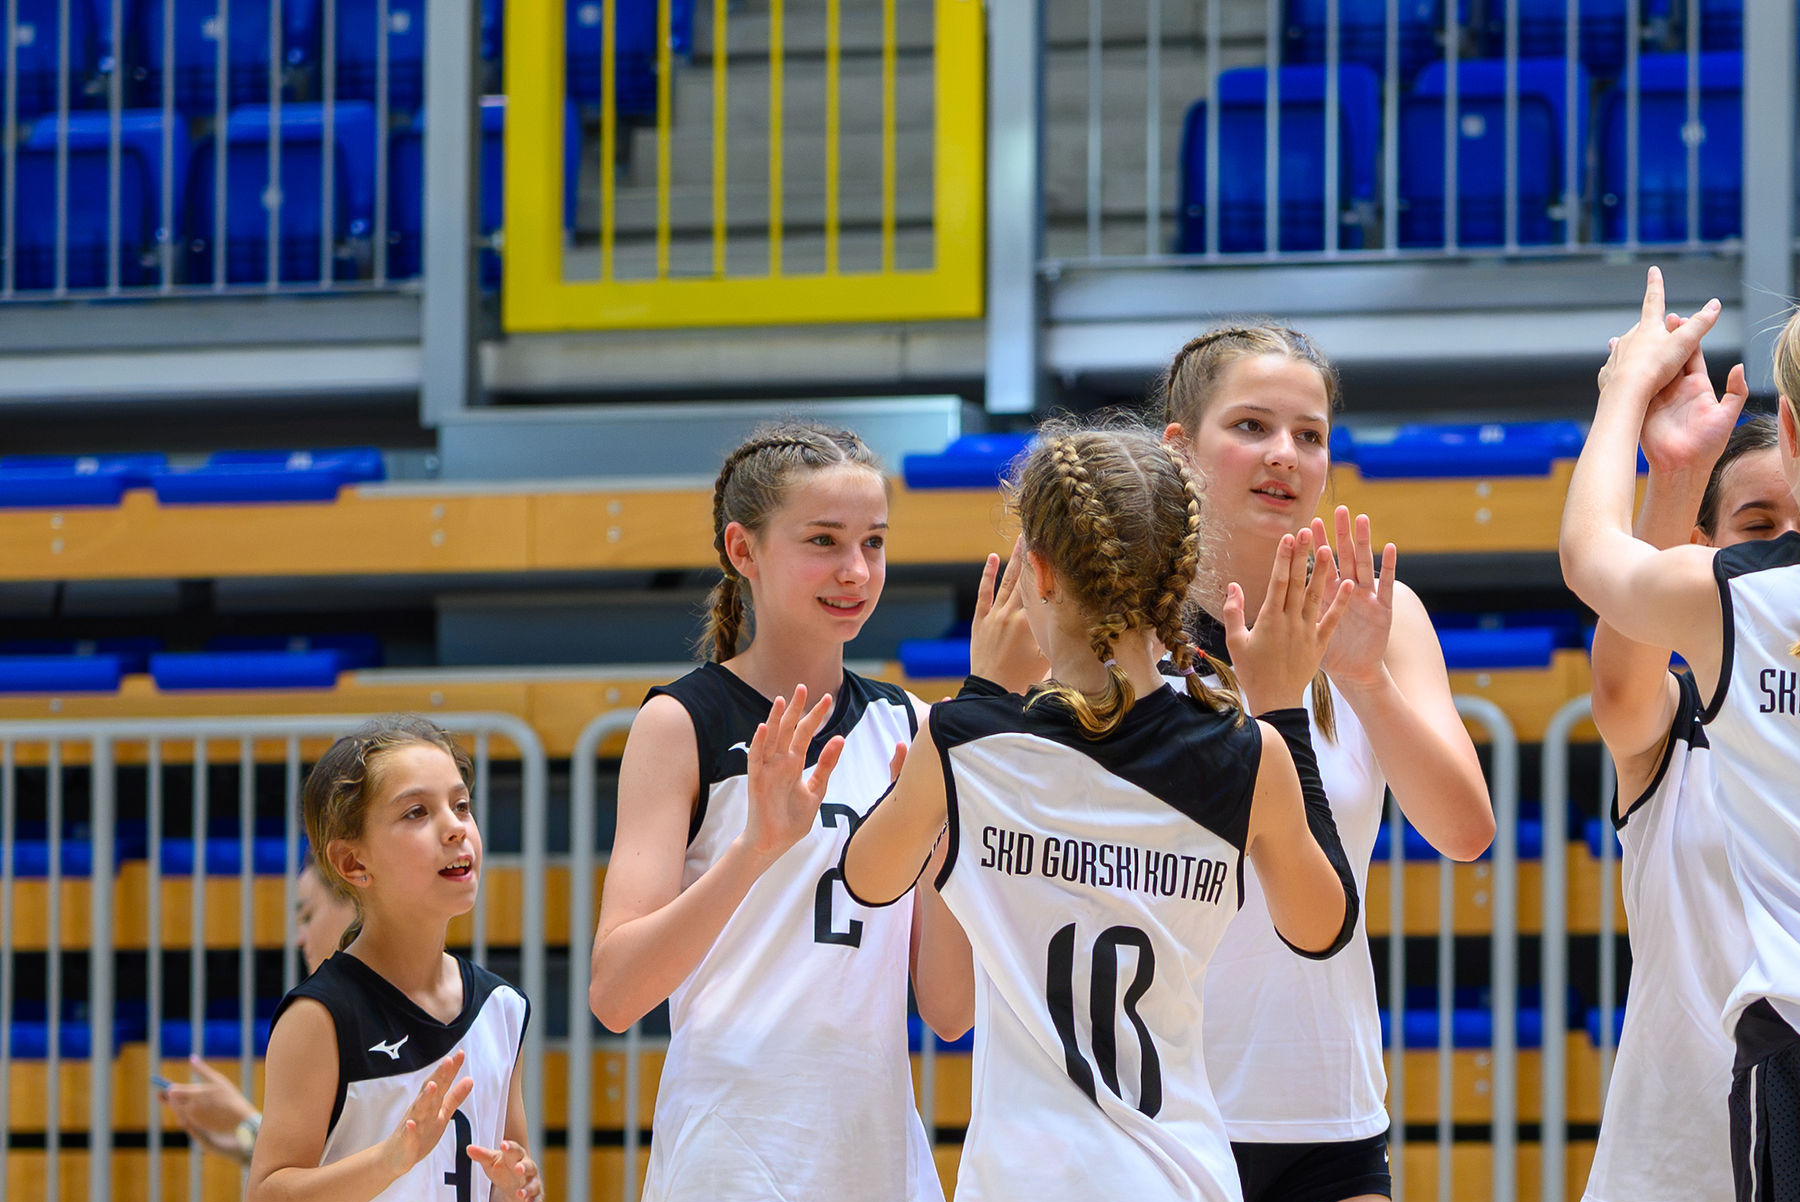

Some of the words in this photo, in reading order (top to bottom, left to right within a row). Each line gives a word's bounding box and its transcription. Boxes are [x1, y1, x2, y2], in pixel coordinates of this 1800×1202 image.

[814, 803, 863, 948] 2
[981, 826, 1035, 876] SKD
[1042, 837, 1139, 892] GORSKI
[1143, 850, 1228, 905] KOTAR
